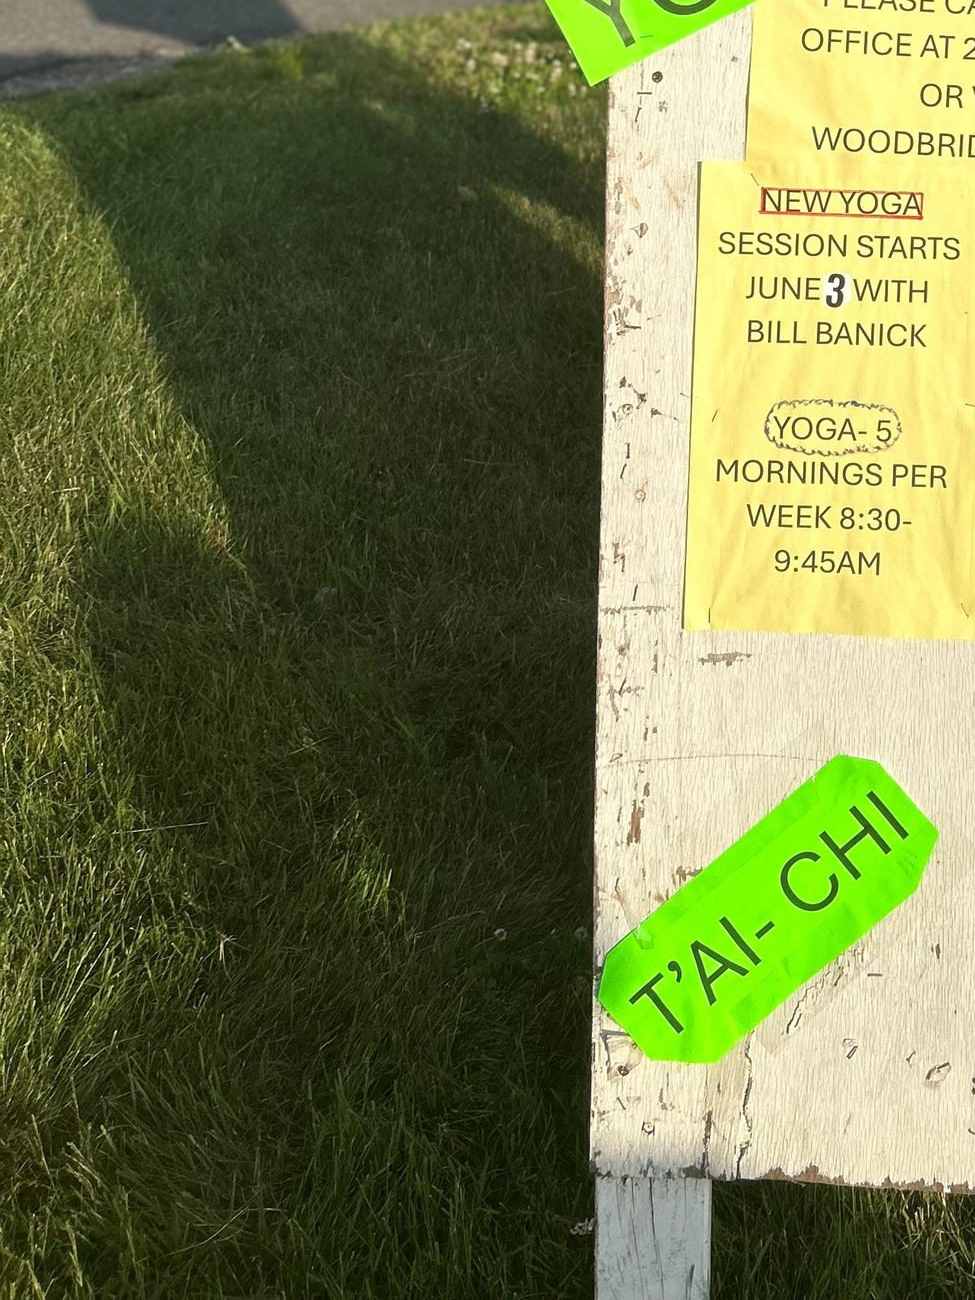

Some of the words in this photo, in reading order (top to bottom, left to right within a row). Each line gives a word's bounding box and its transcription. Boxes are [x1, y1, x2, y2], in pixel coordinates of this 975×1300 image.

[800, 27, 913, 58] OFFICE
[919, 34, 956, 60] AT
[919, 82, 964, 110] OR
[762, 188, 832, 213] NEW
[839, 190, 923, 216] YOGA
[717, 231, 848, 258] SESSION
[856, 234, 961, 261] STARTS
[745, 275, 821, 301] JUNE
[825, 273, 847, 309] 3
[853, 278, 929, 304] WITH
[747, 319, 808, 345] BILL
[815, 321, 928, 348] BANICK
[773, 415, 868, 442] YOGA-
[875, 419, 893, 443] 5
[716, 458, 883, 487] MORNINGS
[891, 463, 948, 489] PER
[746, 503, 833, 530] WEEK
[839, 506, 912, 532] 8:30-
[774, 549, 882, 576] 9:45AM
[628, 915, 776, 1035] T'AI-
[779, 789, 910, 913] CHI
